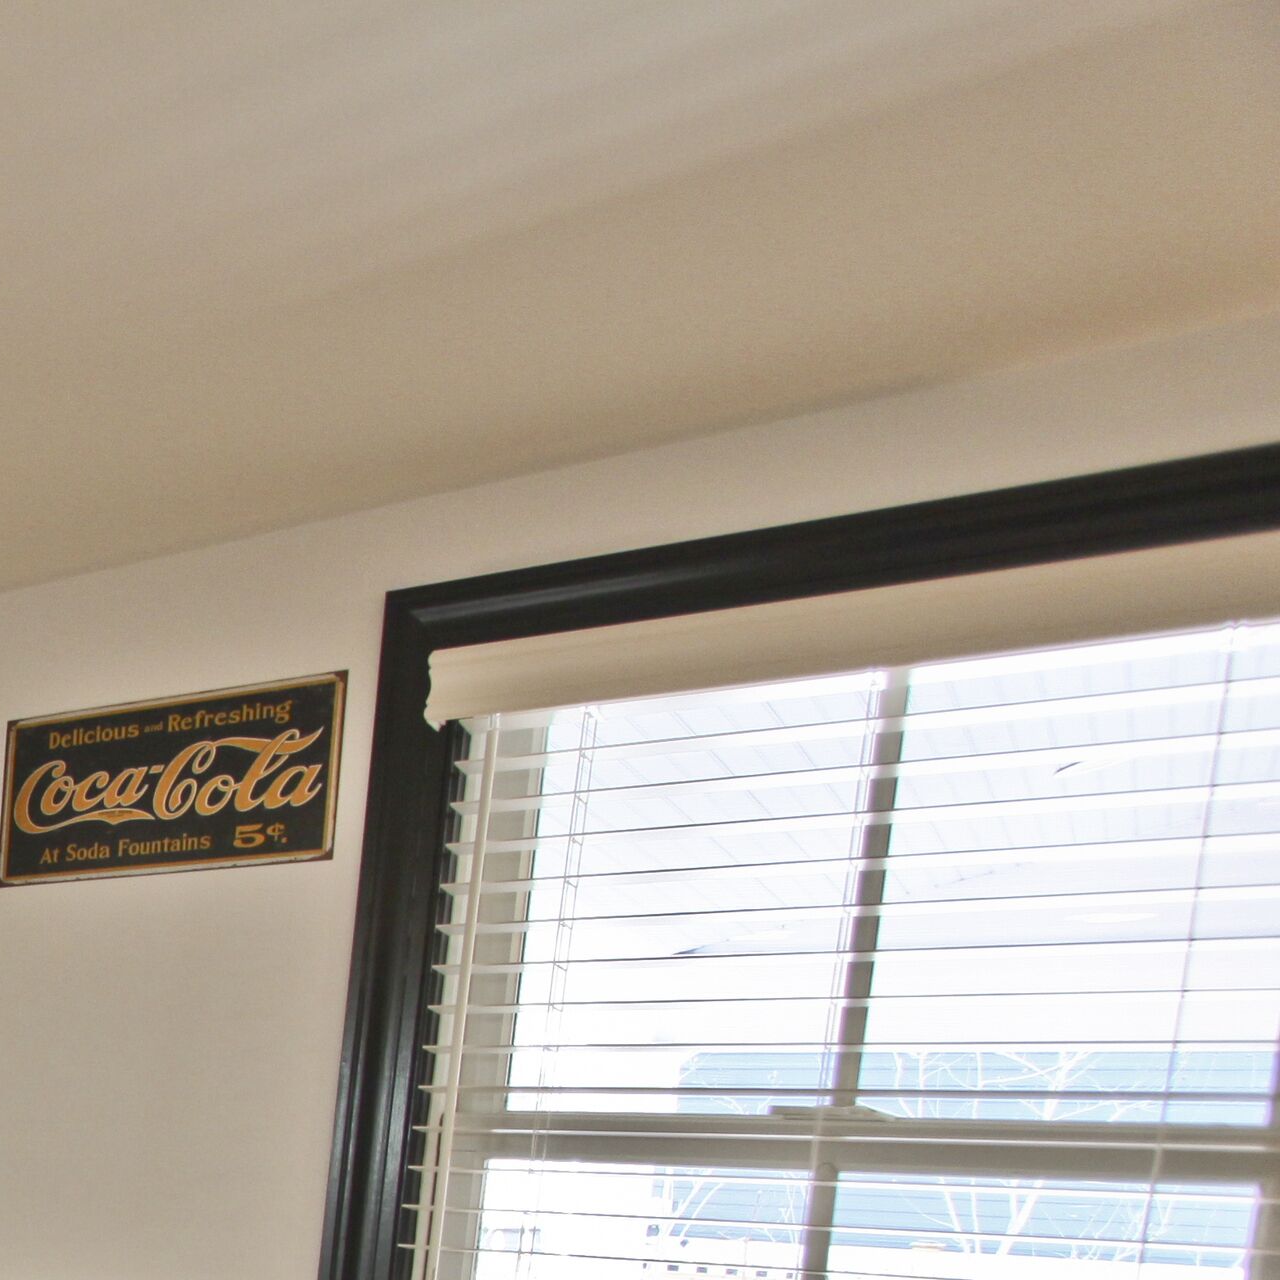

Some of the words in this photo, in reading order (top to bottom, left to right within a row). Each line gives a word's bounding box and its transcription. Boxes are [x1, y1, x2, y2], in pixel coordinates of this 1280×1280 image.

[49, 723, 140, 750] Delicious
[144, 721, 163, 733] and
[167, 700, 292, 733] Refreshing
[14, 725, 324, 834] Coca-Cola
[40, 849, 59, 865] At
[65, 841, 110, 862] Soda
[117, 834, 211, 857] Fountains
